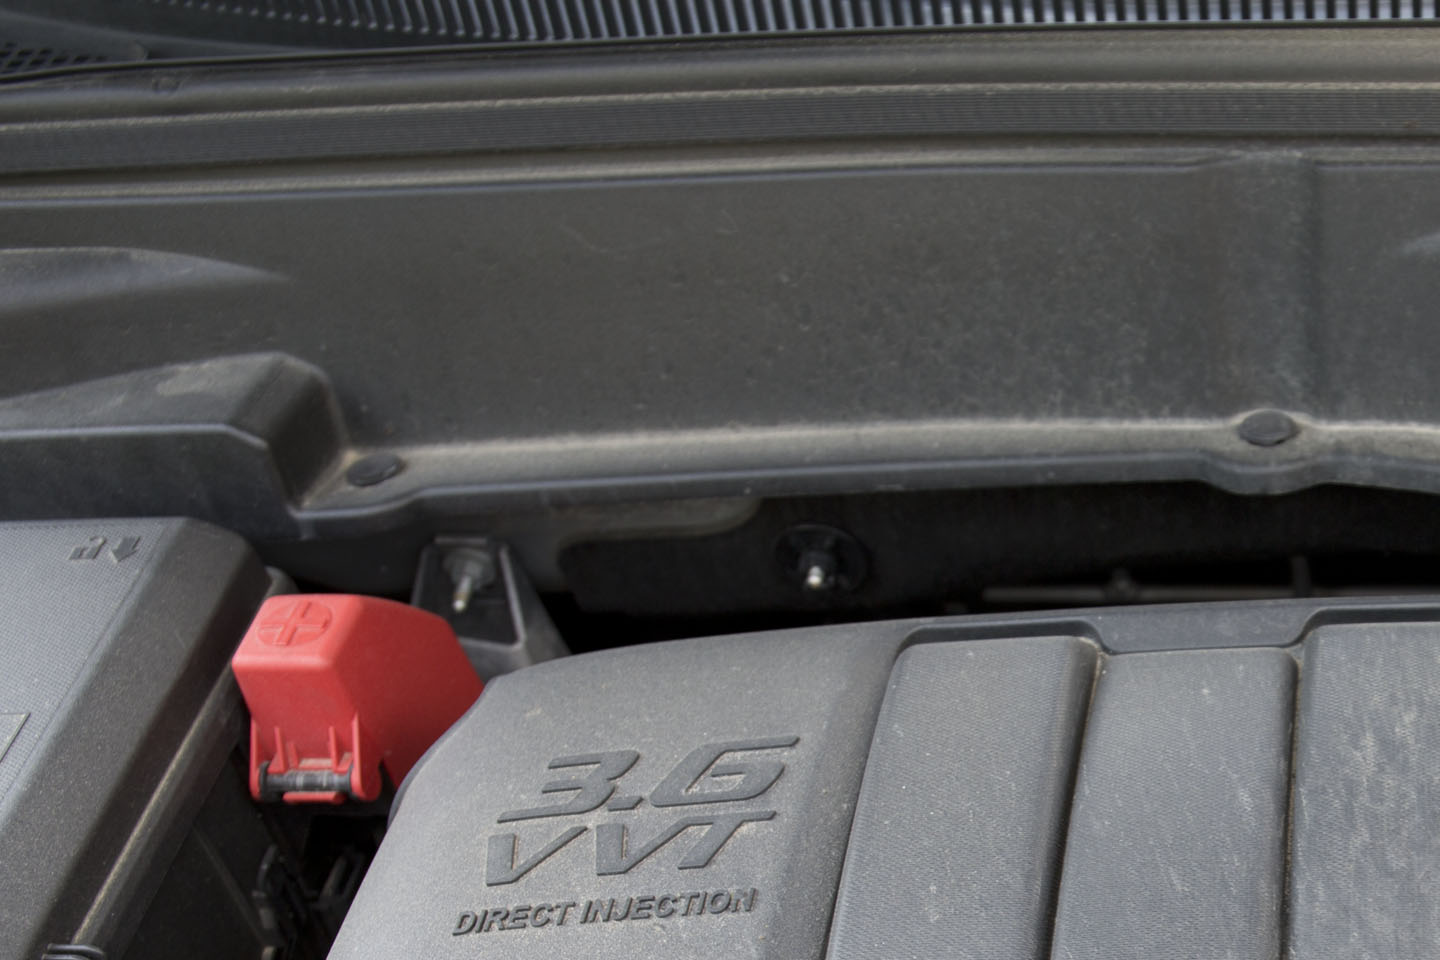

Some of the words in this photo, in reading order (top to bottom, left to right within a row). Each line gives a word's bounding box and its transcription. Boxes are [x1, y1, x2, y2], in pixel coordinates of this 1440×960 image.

[497, 735, 800, 824] 3.6
[486, 810, 777, 887] VVT
[452, 902, 575, 936] DIRECT
[580, 888, 759, 924] INJECTION
